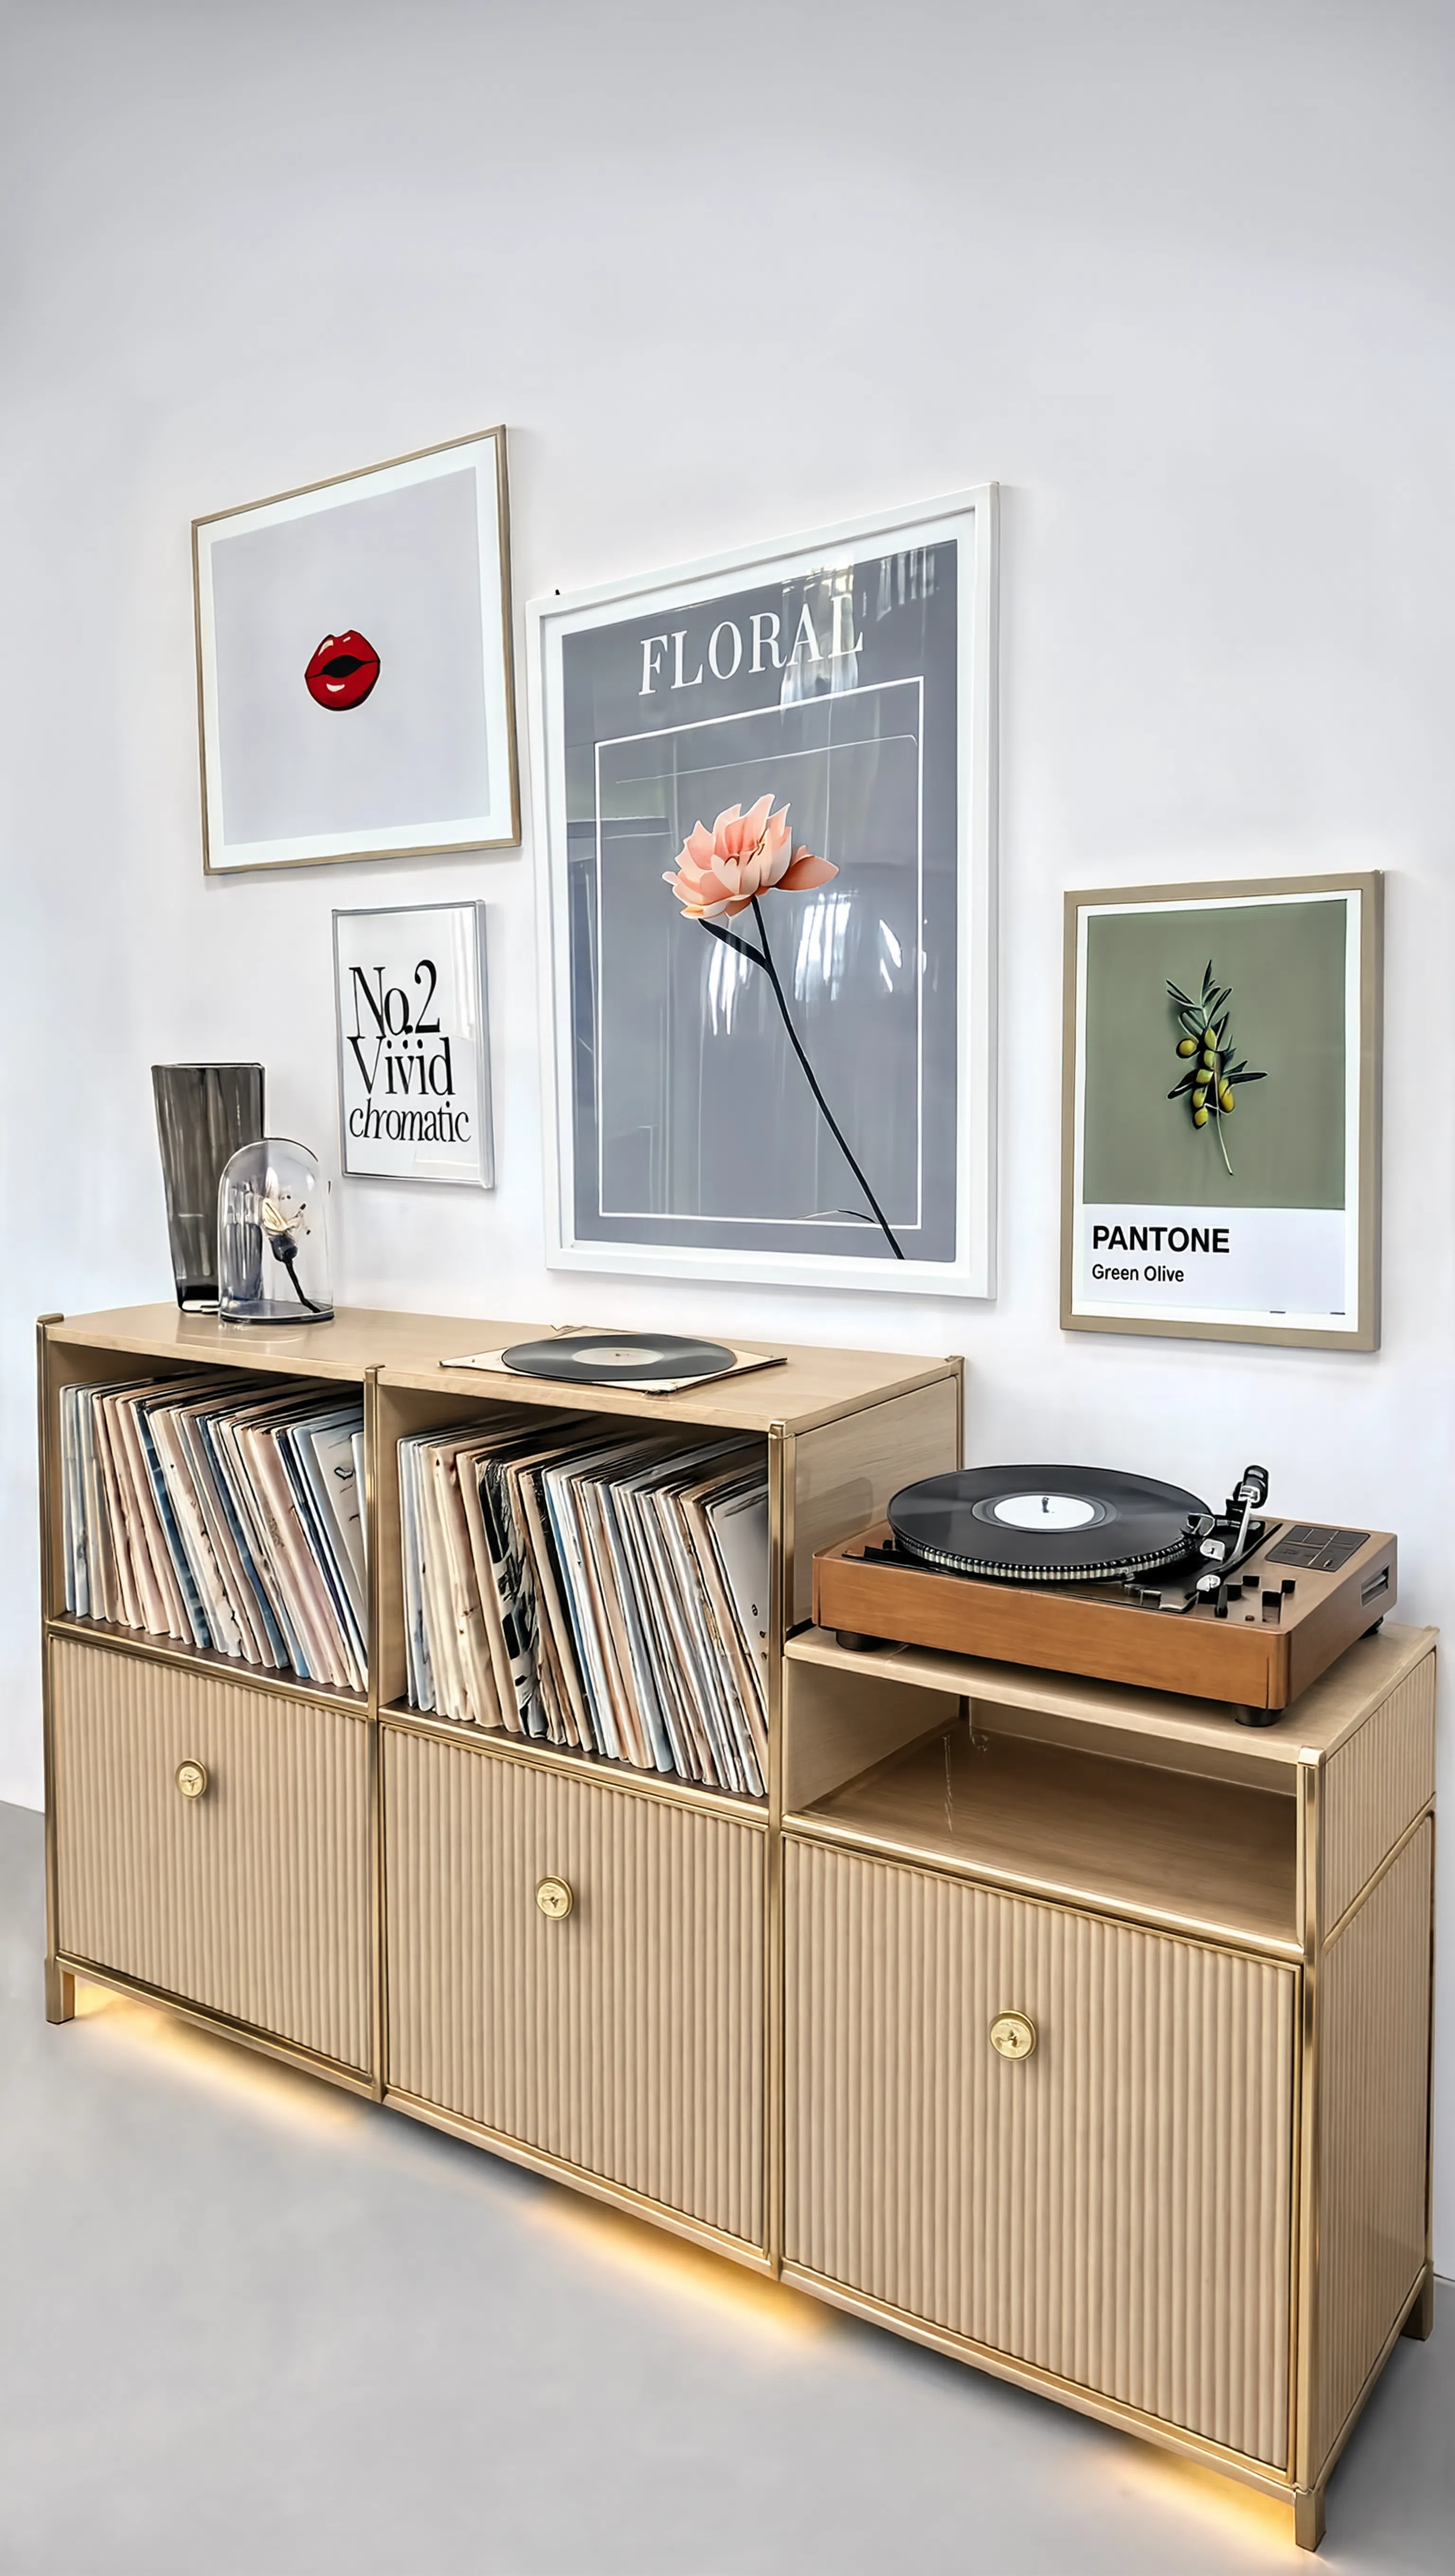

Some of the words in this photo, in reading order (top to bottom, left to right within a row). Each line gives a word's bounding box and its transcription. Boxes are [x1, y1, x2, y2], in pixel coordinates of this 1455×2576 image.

[639, 593, 863, 696] FLORAL
[349, 959, 440, 1038] No.2
[347, 1037, 456, 1095] Vivid
[349, 1098, 471, 1142] chromatic
[1093, 1225, 1230, 1253] PANTONE
[1092, 1264, 1139, 1280] Green
[1144, 1265, 1184, 1282] Olive
